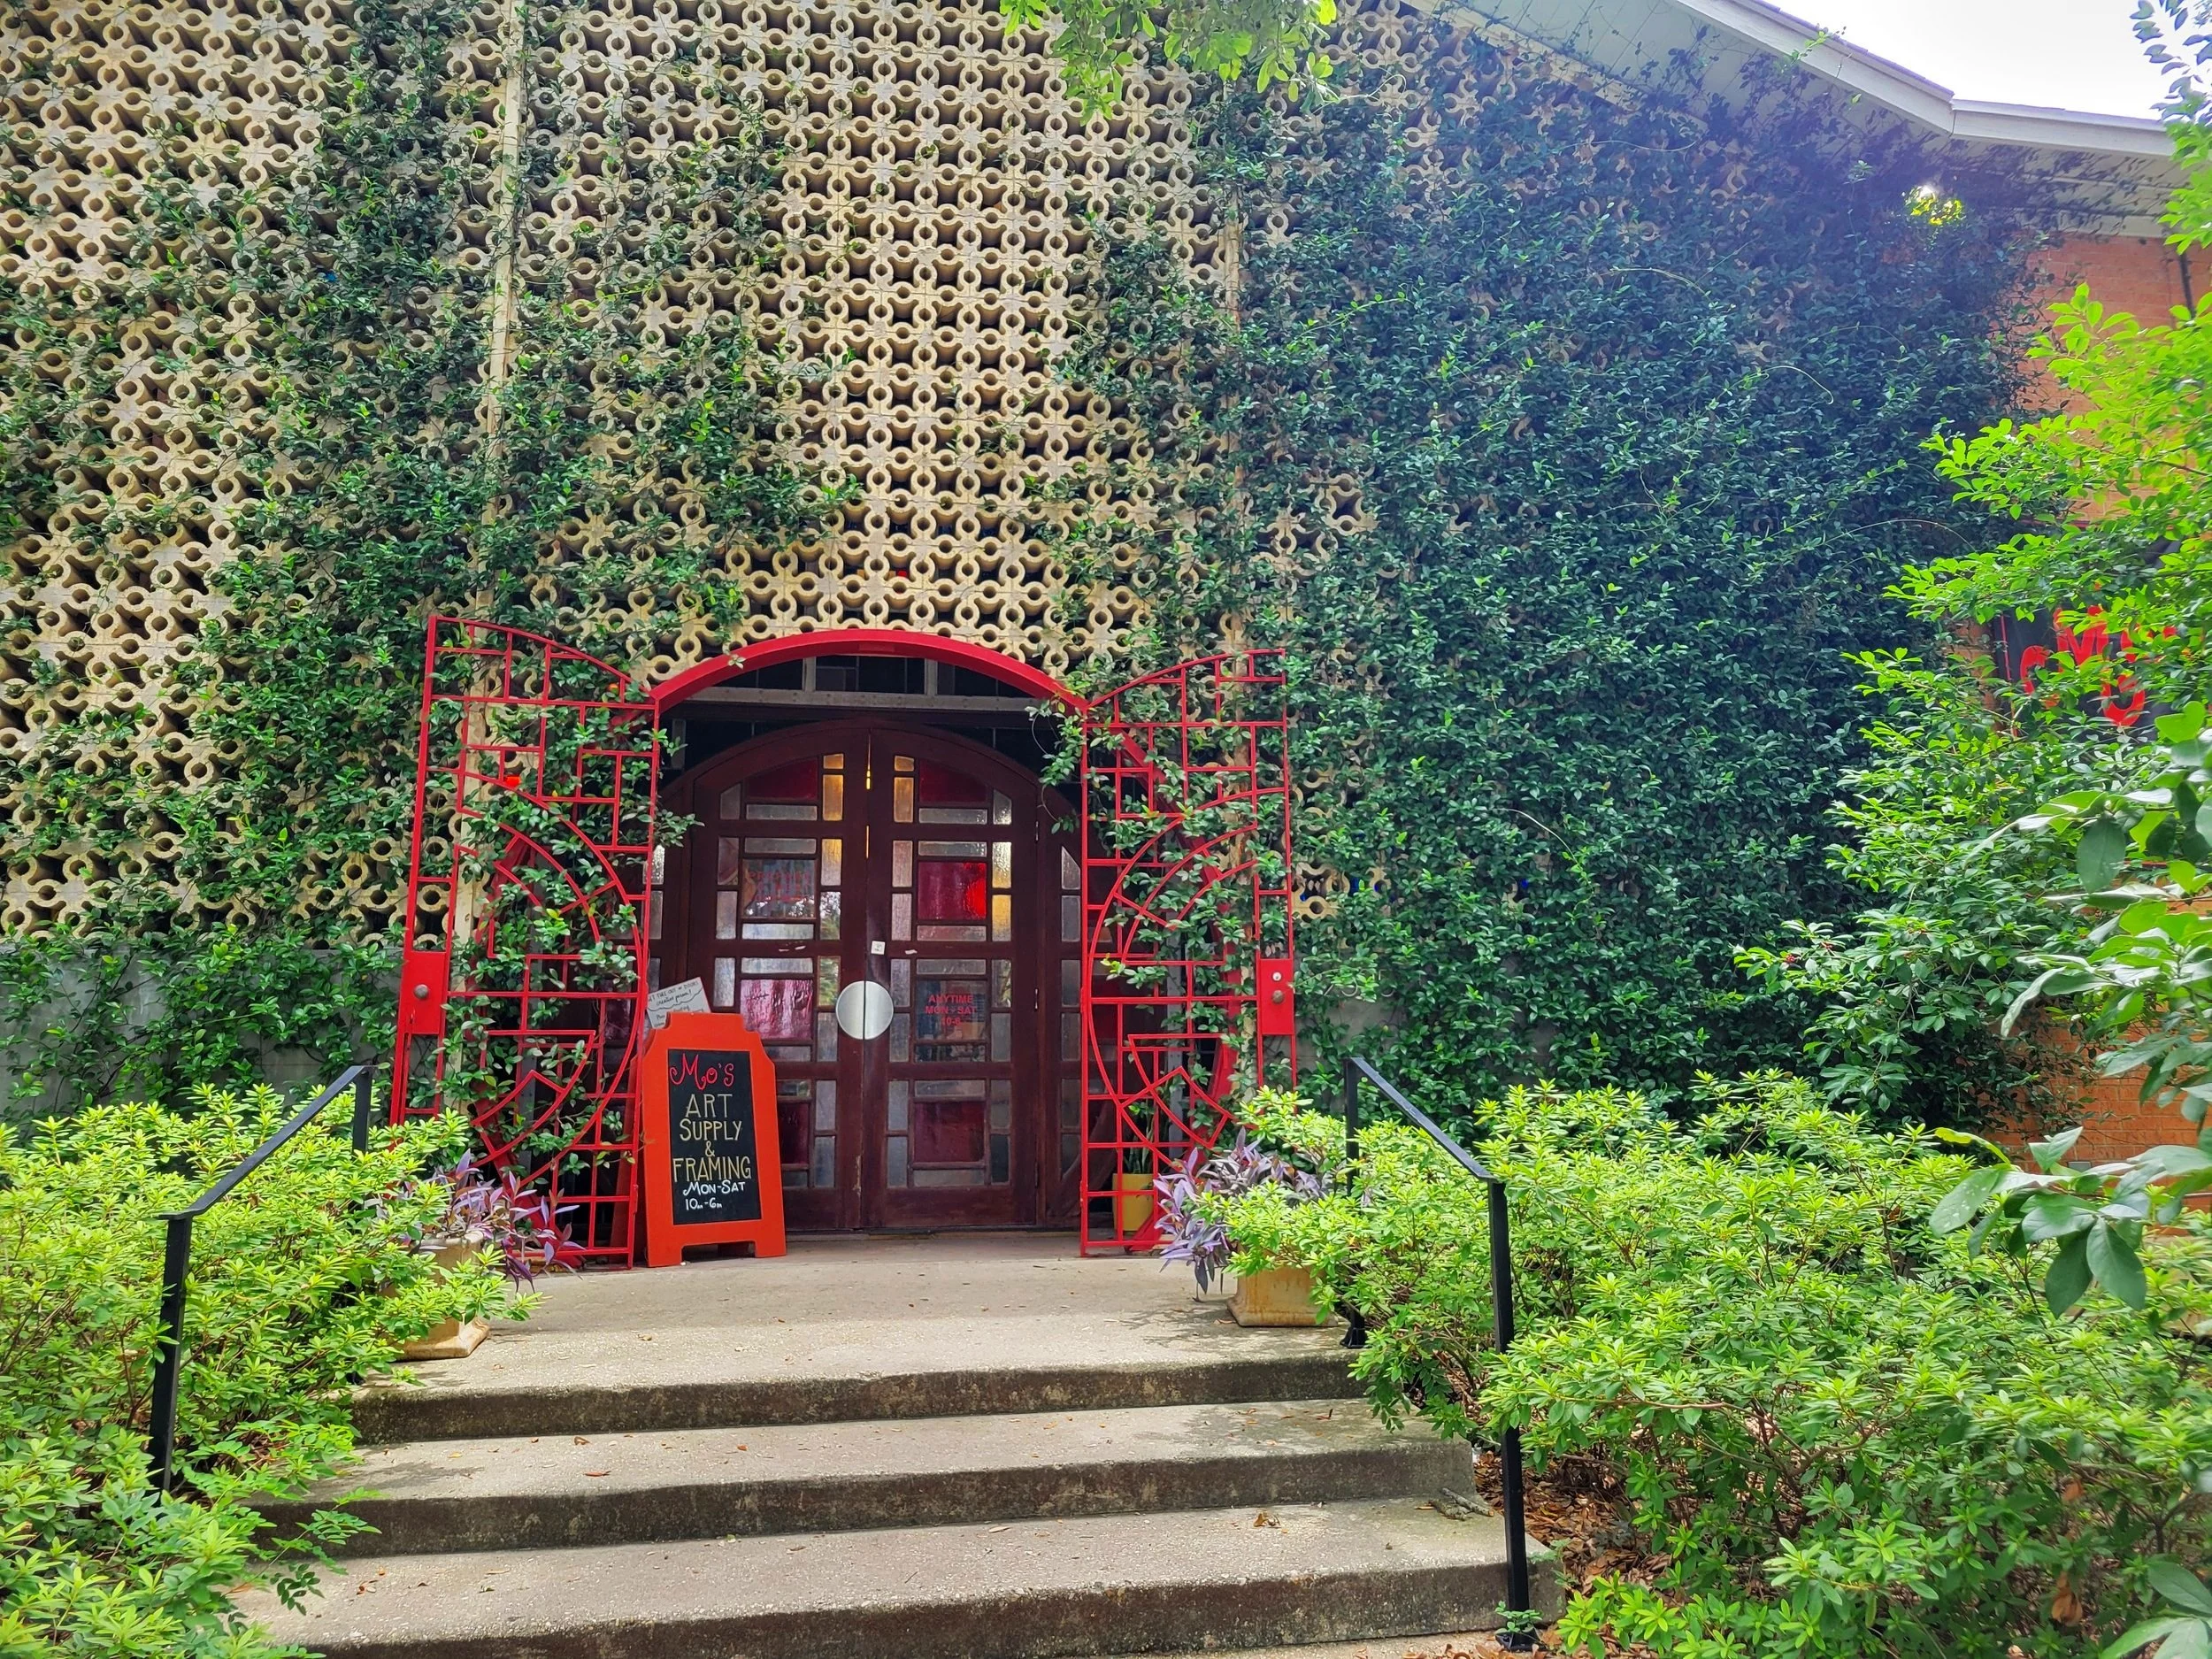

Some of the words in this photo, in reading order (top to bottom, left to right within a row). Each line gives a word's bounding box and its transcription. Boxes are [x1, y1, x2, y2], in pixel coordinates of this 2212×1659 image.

[925, 1005, 949, 1014] MON
[927, 995, 973, 1003] ANYTIME
[670, 1053, 734, 1090] Mo's
[685, 1094, 733, 1118] ART
[680, 1118, 742, 1141] SUPPLY
[704, 1141, 716, 1156] &
[672, 1156, 752, 1182] FRAMING
